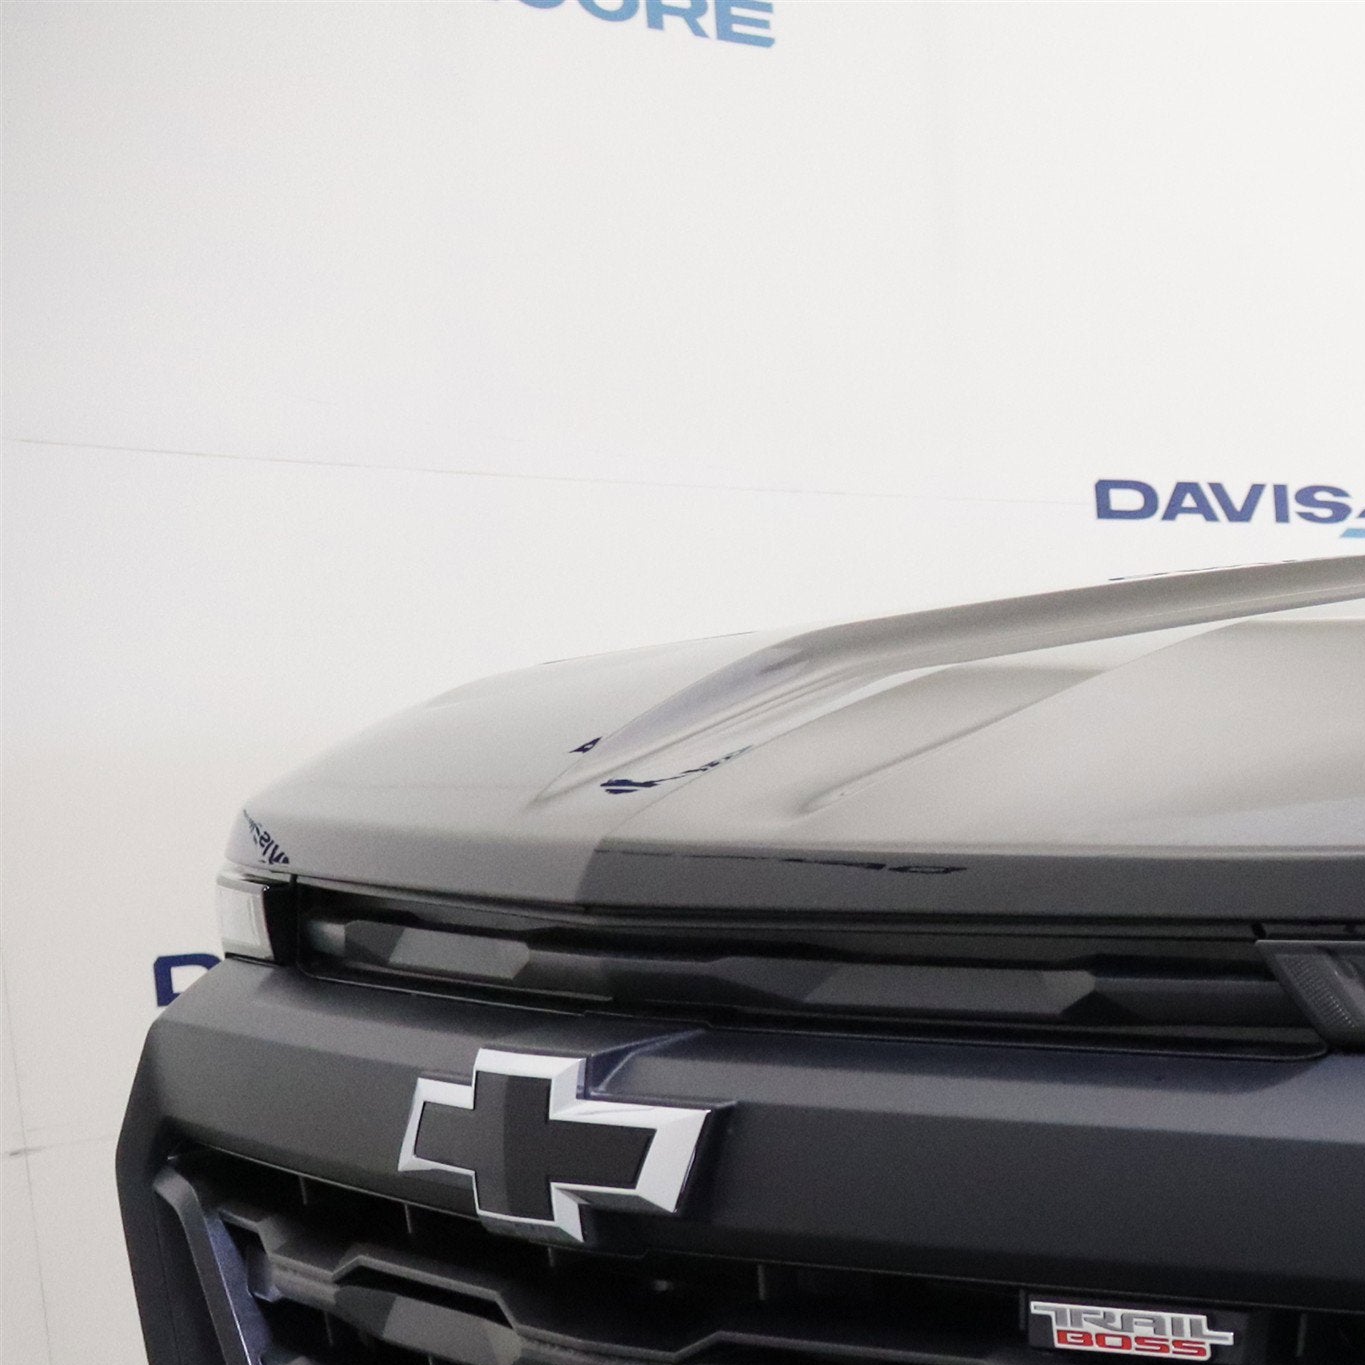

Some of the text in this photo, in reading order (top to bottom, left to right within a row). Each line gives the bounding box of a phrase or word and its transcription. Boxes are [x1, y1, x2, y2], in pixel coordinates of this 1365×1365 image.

[1094, 478, 1353, 524] DAVIS
[1030, 1301, 1234, 1347] TRAIL
[1056, 1329, 1208, 1359] BOSS
